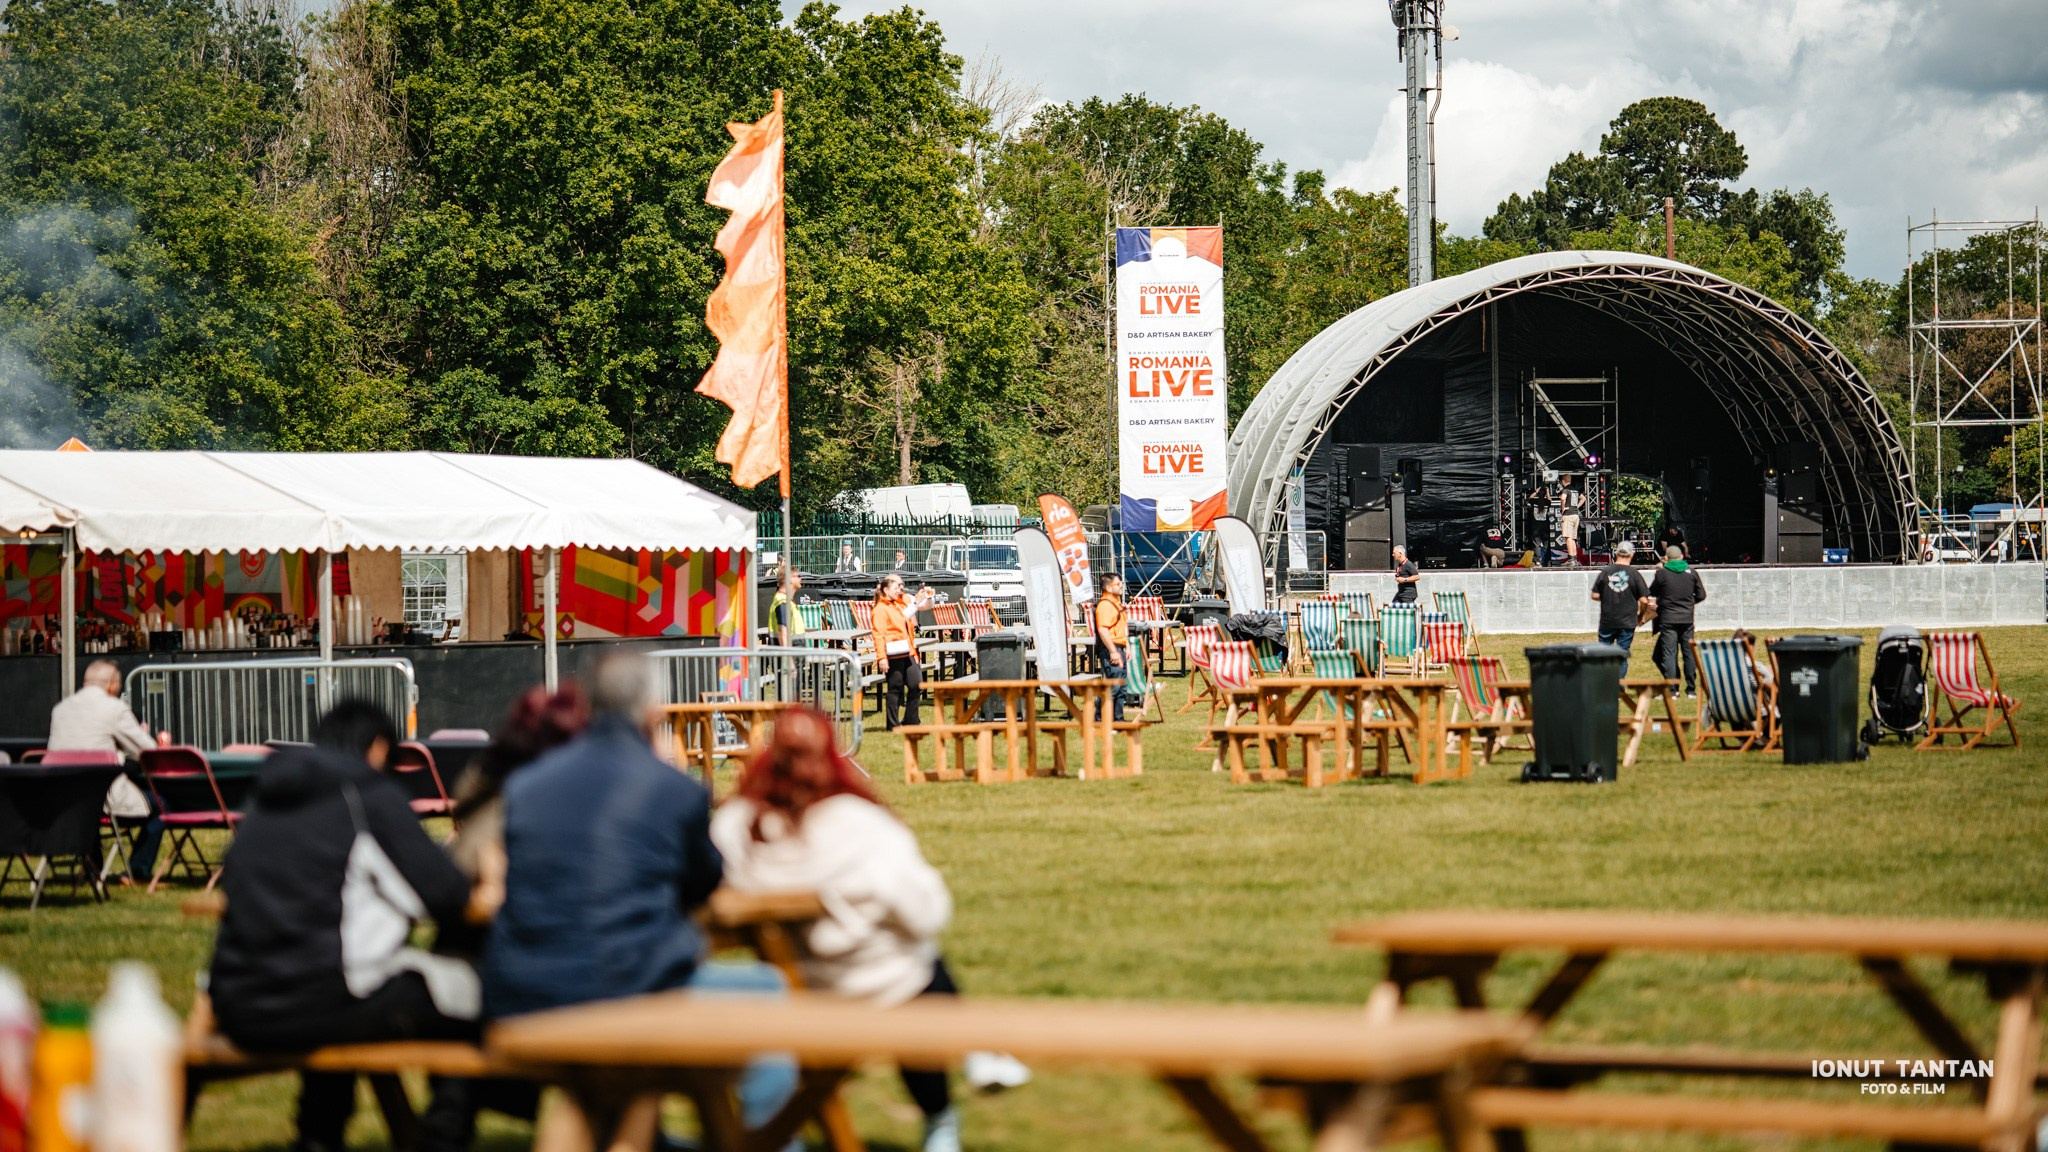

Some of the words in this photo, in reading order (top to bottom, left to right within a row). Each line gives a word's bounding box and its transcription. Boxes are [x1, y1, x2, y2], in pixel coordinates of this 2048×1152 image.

[1139, 285, 1200, 295] ROMANIA
[1140, 294, 1200, 315] LIVE
[1129, 356, 1212, 369] ROMANIA
[1129, 369, 1214, 398] LIVE
[1148, 418, 1182, 426] ARTISAN
[1183, 417, 1215, 425] BAKERY
[1143, 443, 1203, 454] ROMANIA
[1143, 453, 1204, 474] LIVE
[1048, 503, 1071, 524] ria
[98, 557, 125, 609] LOVE
